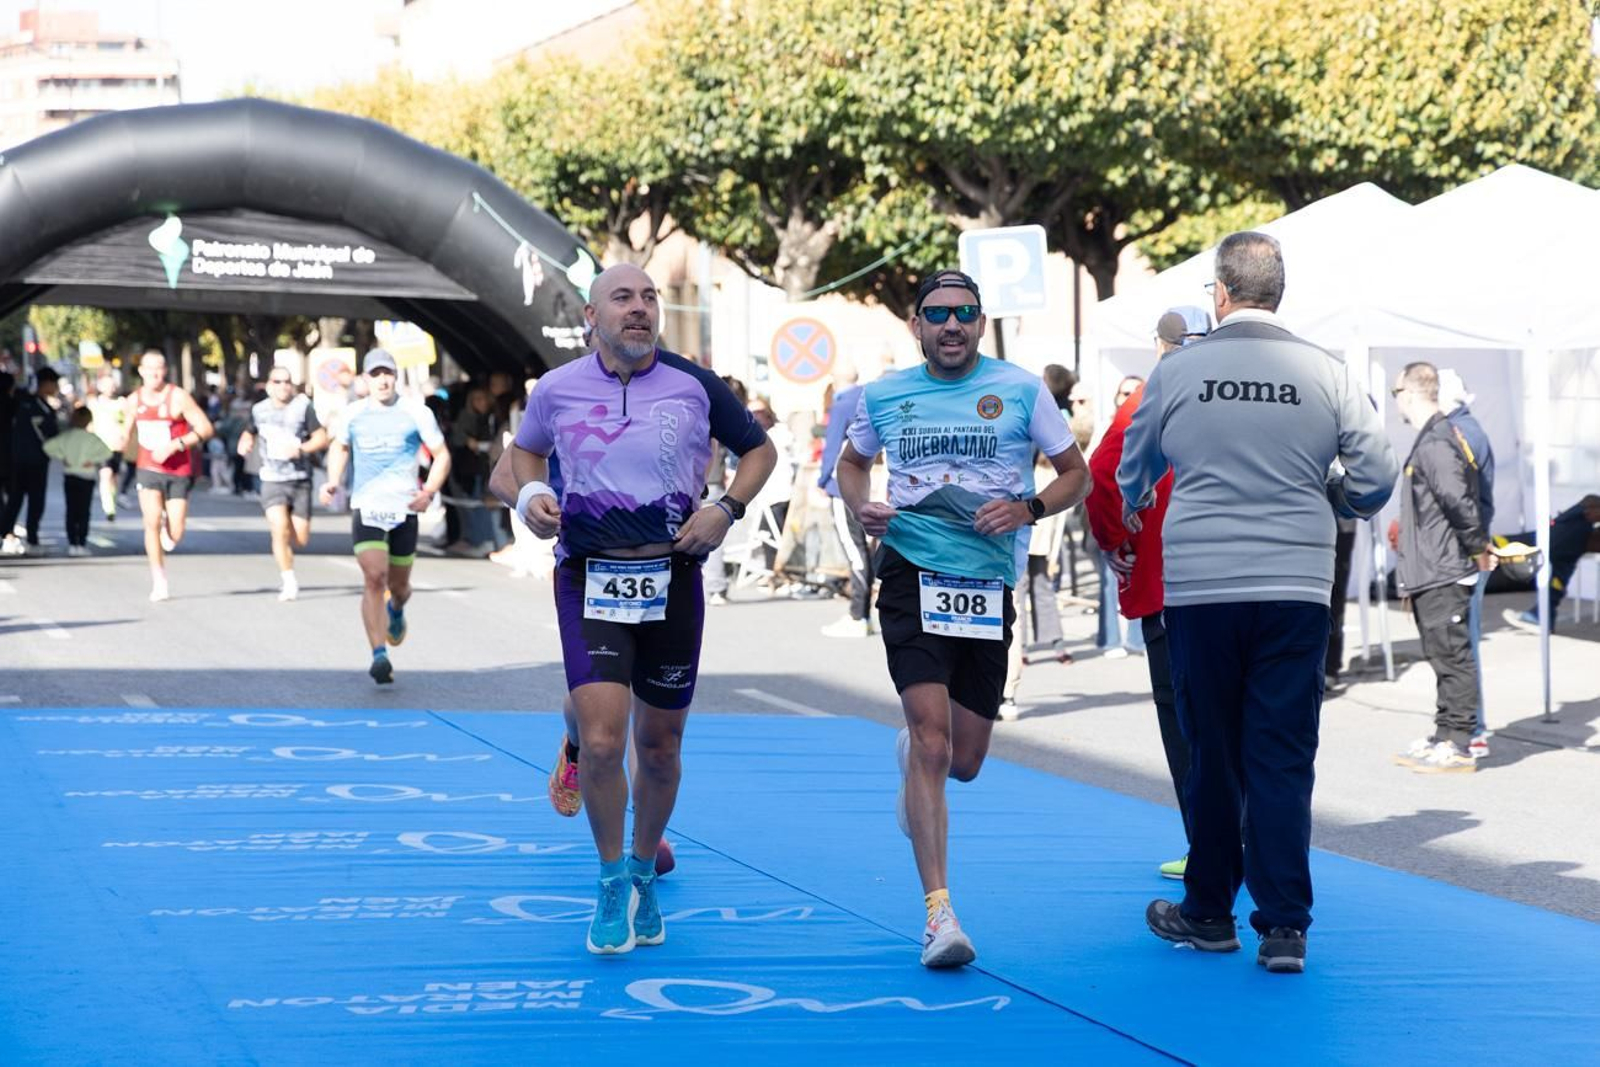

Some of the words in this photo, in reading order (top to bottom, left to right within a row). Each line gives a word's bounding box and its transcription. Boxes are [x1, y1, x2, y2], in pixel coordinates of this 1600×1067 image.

[273, 242, 351, 264] Municipal
[352, 246, 376, 264] de
[192, 256, 267, 278] Deportes
[268, 261, 291, 277] de
[978, 239, 1030, 309] P
[1198, 380, 1301, 406] Joma
[919, 426, 942, 435] SUBIDA
[943, 426, 951, 434] AL
[984, 425, 995, 434] DEL
[899, 434, 998, 464] QUIEBRAJANO
[603, 577, 657, 599] 436
[936, 591, 987, 616] 308
[345, 1002, 580, 1014] MEDIA
